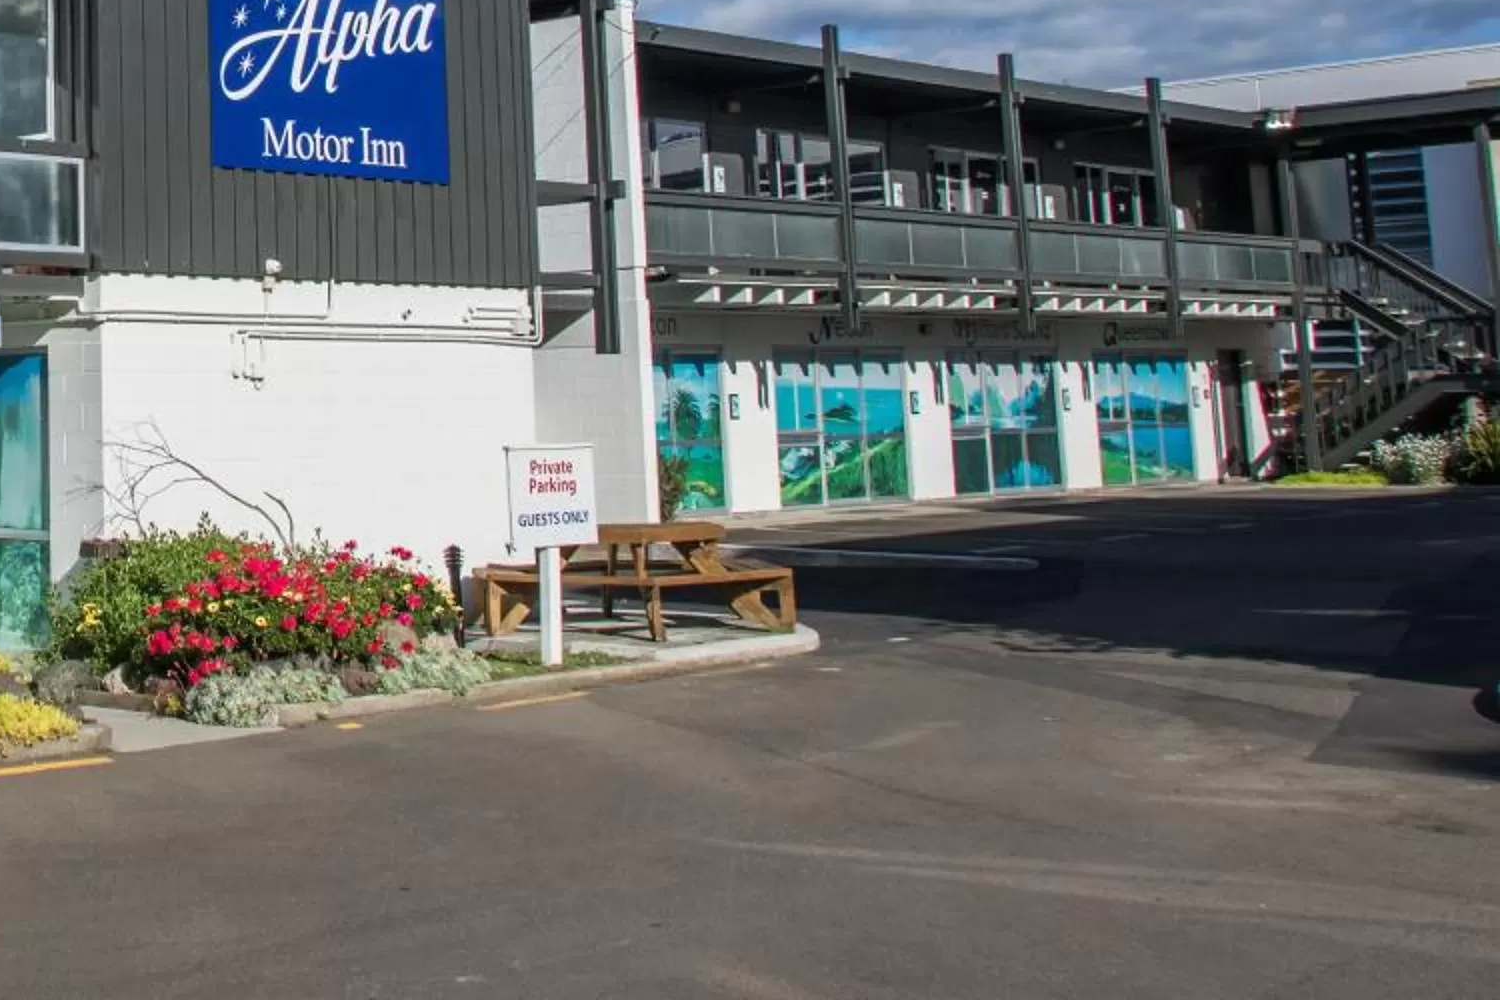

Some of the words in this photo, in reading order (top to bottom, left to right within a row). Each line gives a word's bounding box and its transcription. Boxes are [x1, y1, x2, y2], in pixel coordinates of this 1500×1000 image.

[261, 117, 354, 164] Motor
[360, 127, 407, 168] Inn
[529, 458, 573, 475] Private
[528, 477, 577, 496] Parking
[518, 511, 560, 527] GUESTS
[561, 509, 589, 524] ONLY
